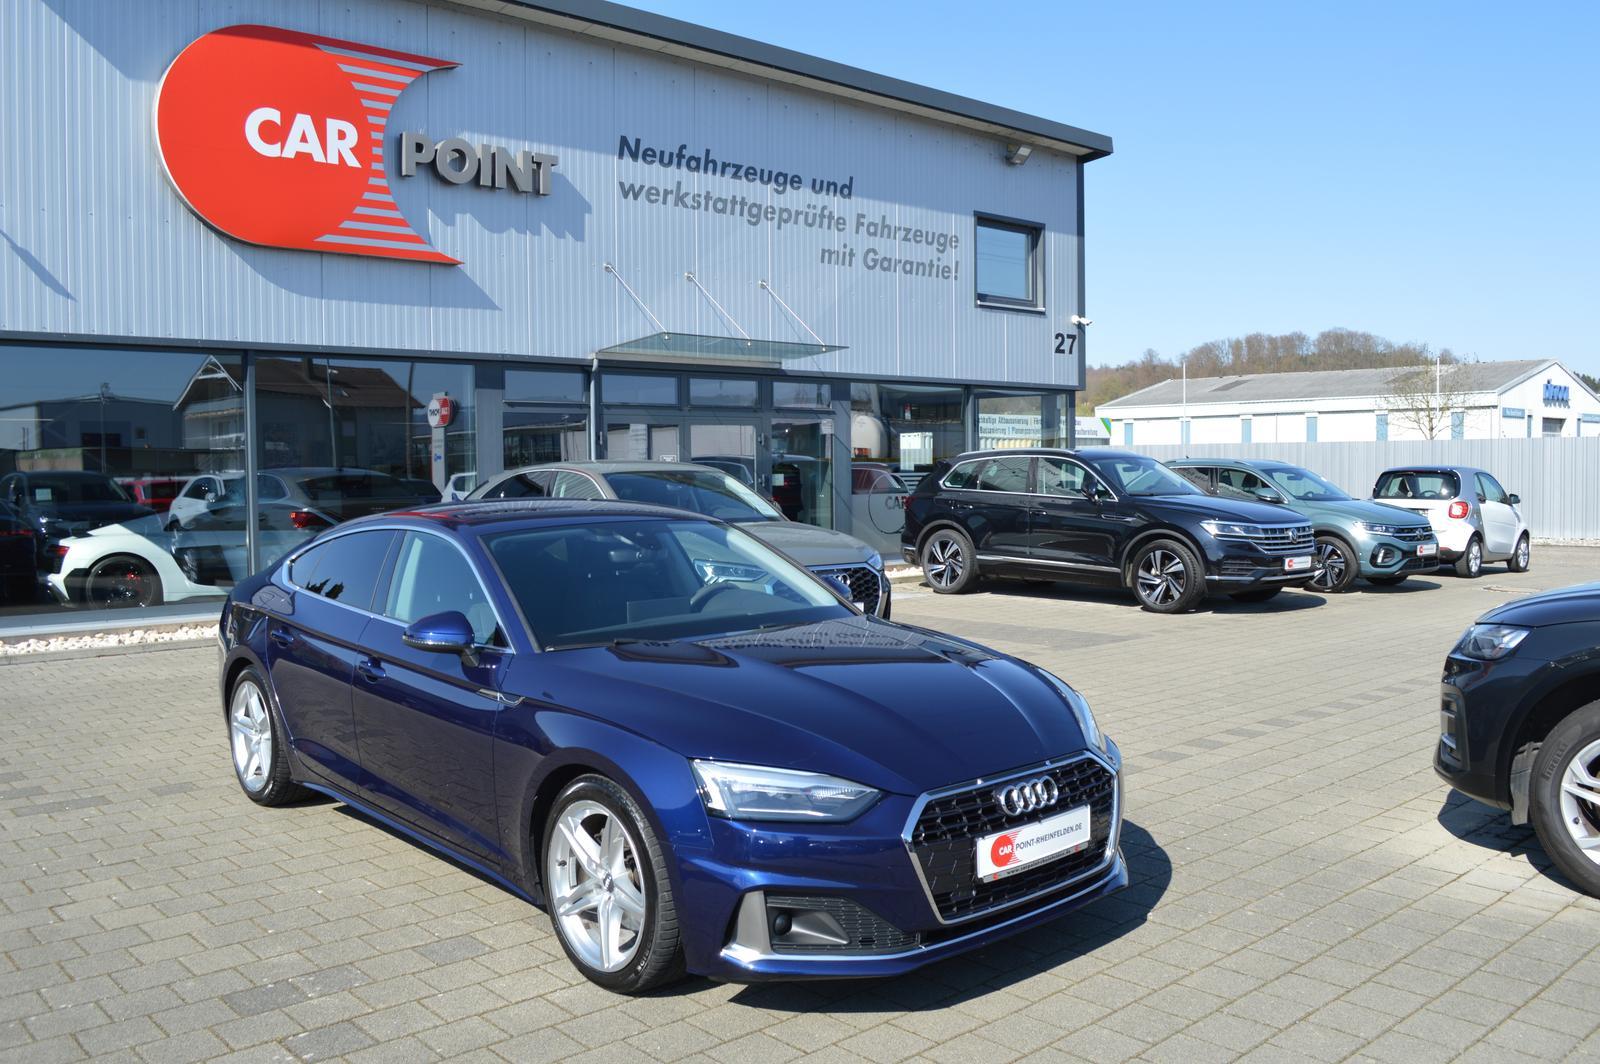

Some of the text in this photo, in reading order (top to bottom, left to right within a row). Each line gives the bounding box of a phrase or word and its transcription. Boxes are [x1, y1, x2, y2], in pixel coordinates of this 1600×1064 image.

[244, 107, 559, 197] CAR POINT
[617, 135, 854, 200] Neufahrzeuge und
[618, 179, 960, 251] werkstattgeprüfte Fahrzeuge
[819, 243, 960, 281] mit Garantie!
[1054, 331, 1078, 355] 27
[998, 823, 1082, 856] CAR POINT-RHEINFELDEN.DE
